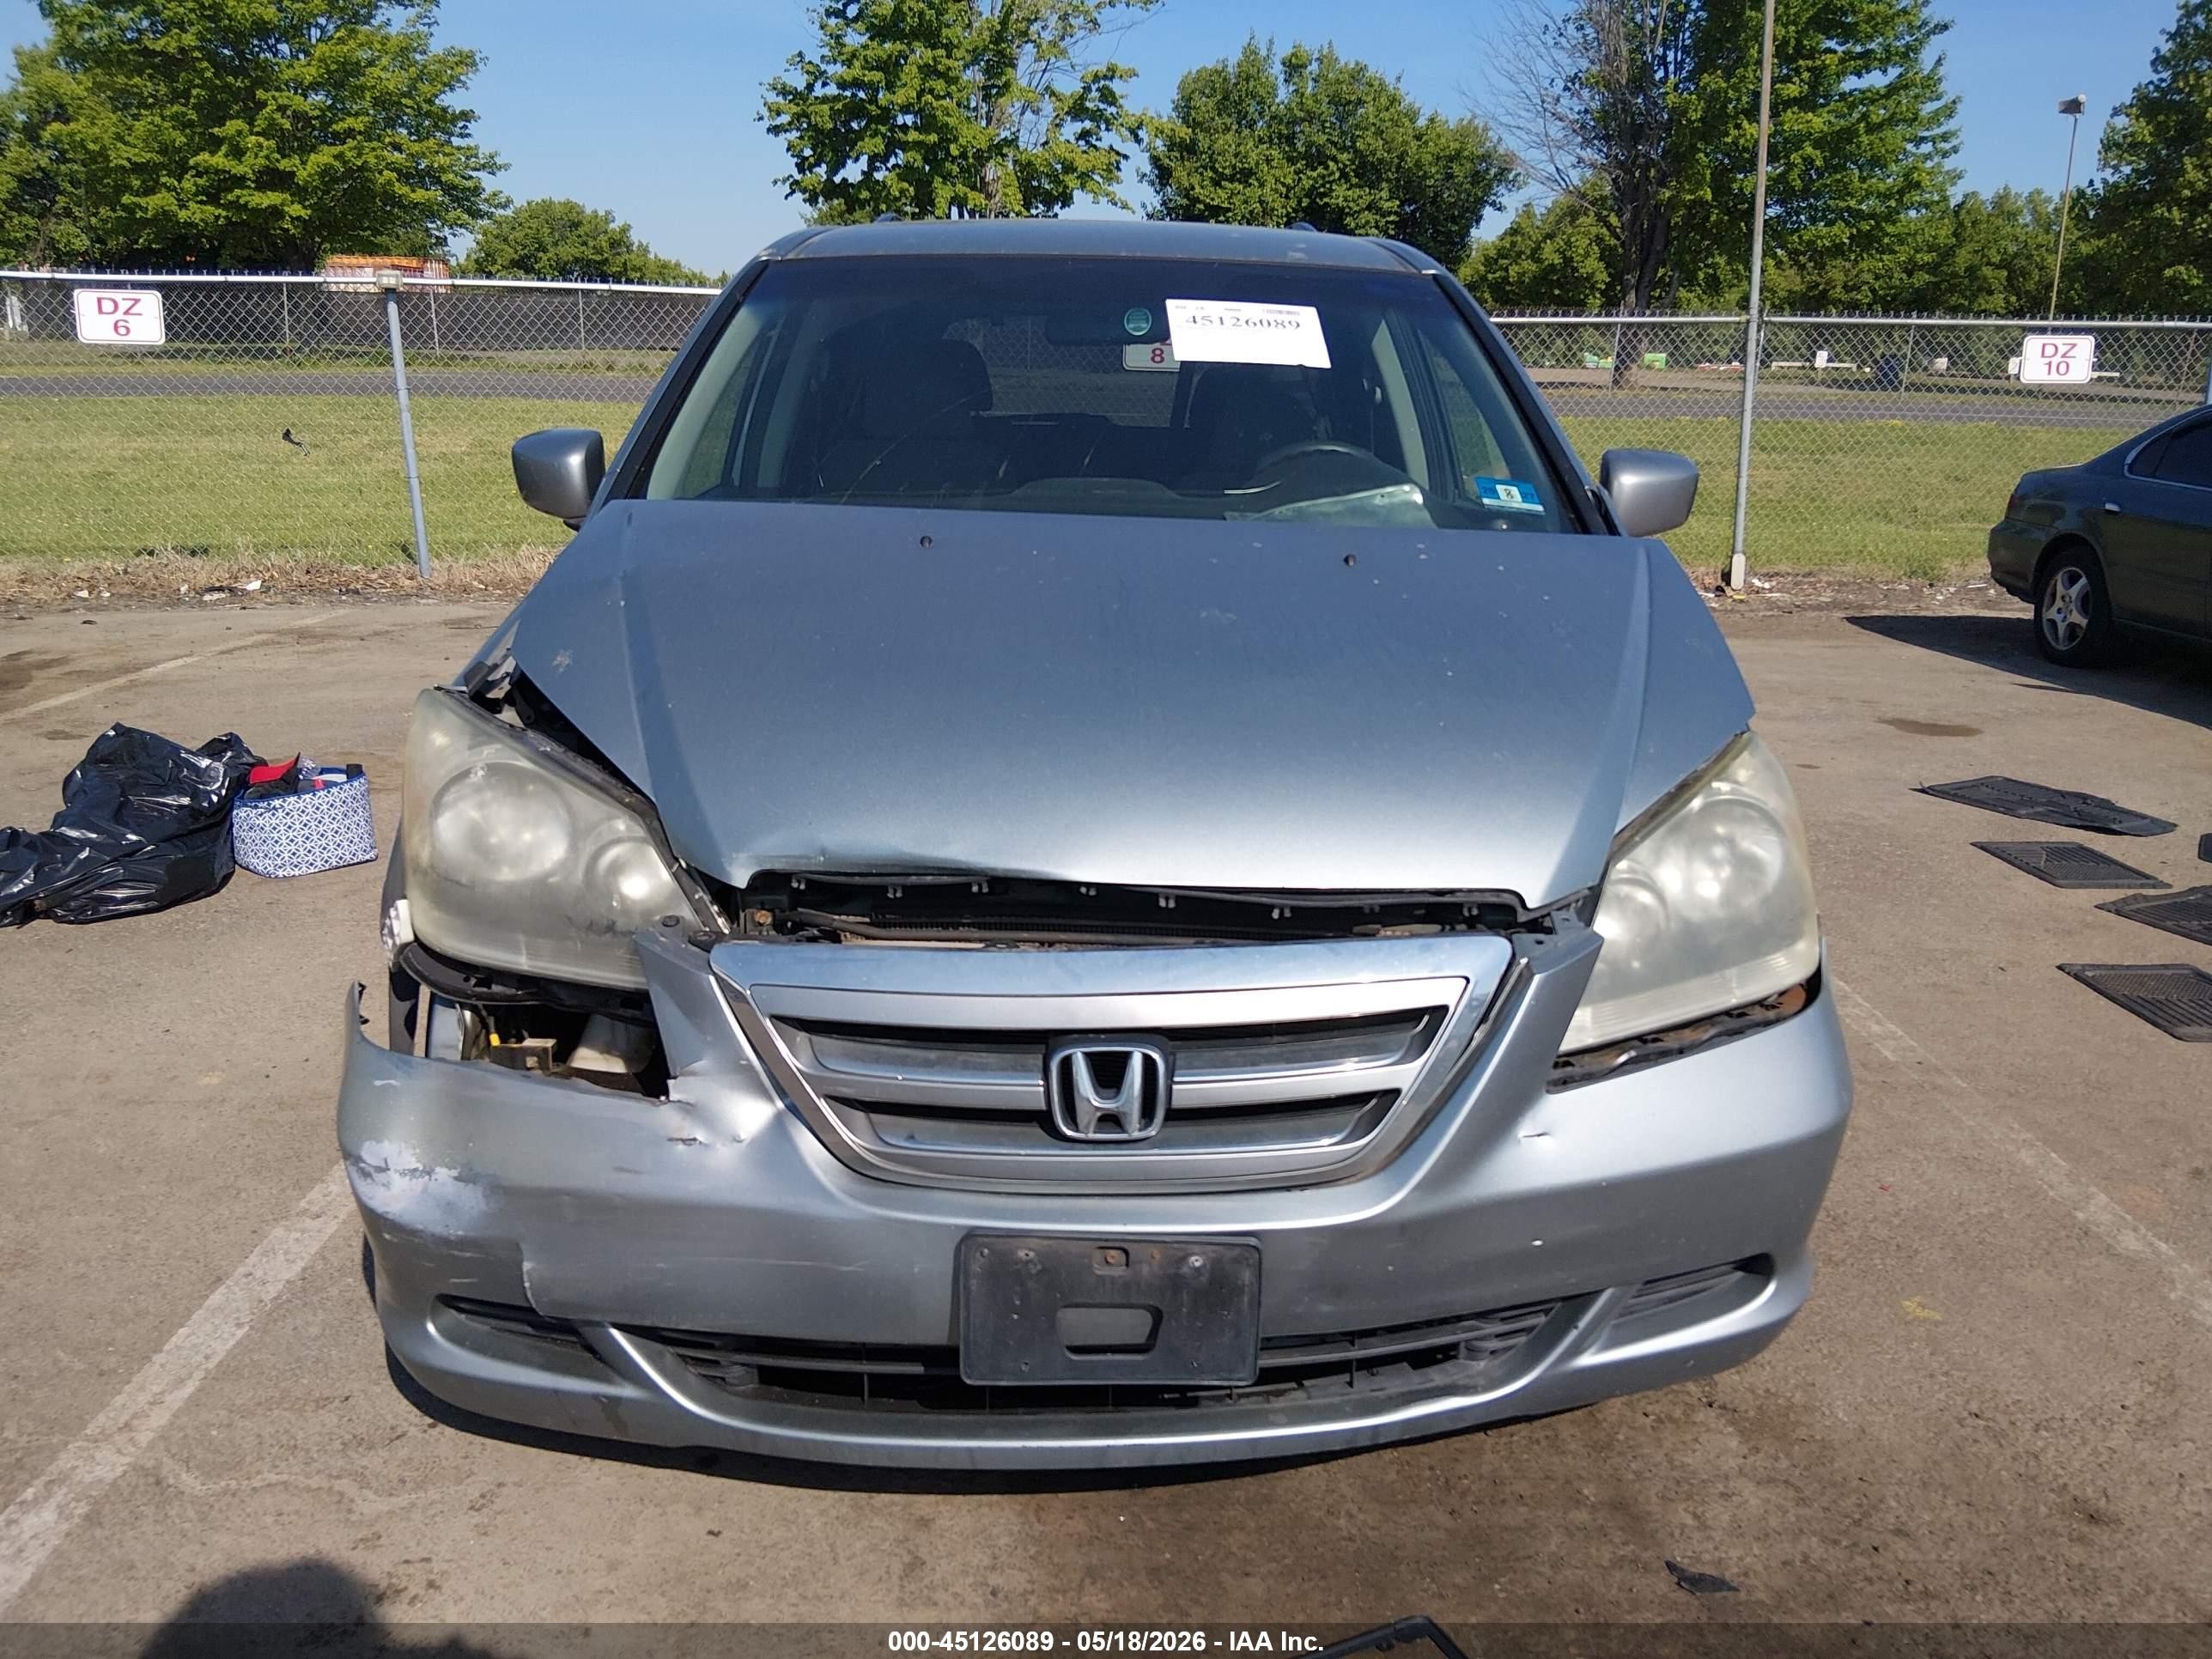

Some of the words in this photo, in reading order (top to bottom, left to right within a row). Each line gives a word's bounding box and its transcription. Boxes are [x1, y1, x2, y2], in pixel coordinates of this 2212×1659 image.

[96, 296, 143, 316] DZ
[113, 319, 131, 337] 6
[1185, 314, 1301, 331] 45126089
[1150, 348, 1165, 364] 8
[2040, 343, 2077, 358] DZ
[2043, 361, 2069, 376] 10
